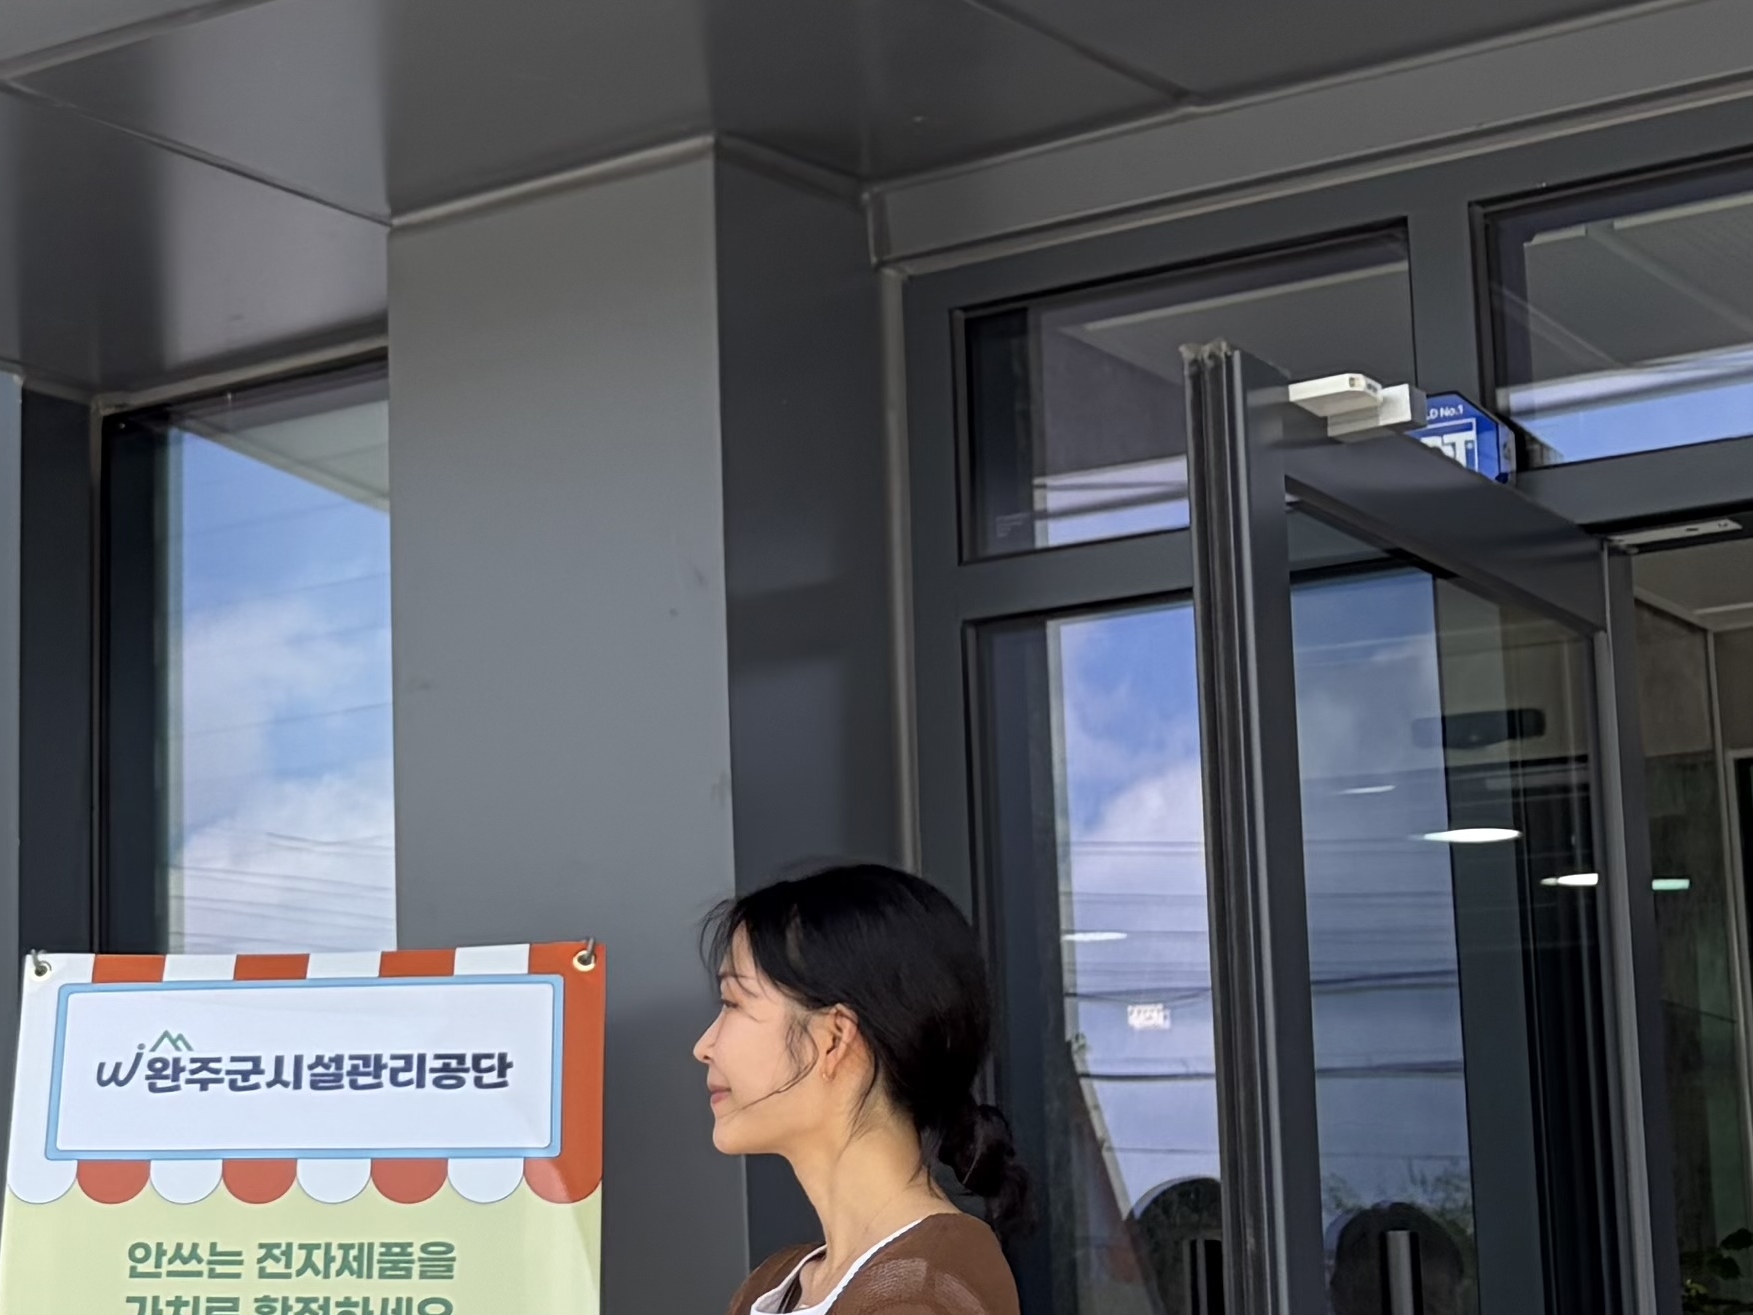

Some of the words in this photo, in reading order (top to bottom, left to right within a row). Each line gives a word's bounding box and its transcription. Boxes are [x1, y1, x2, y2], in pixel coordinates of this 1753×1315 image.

[1439, 404, 1464, 418] No.1
[145, 1050, 514, 1094] 완주군시설관리공단
[127, 1240, 245, 1281] 안쓰는
[256, 1240, 457, 1281] 전자제품을
